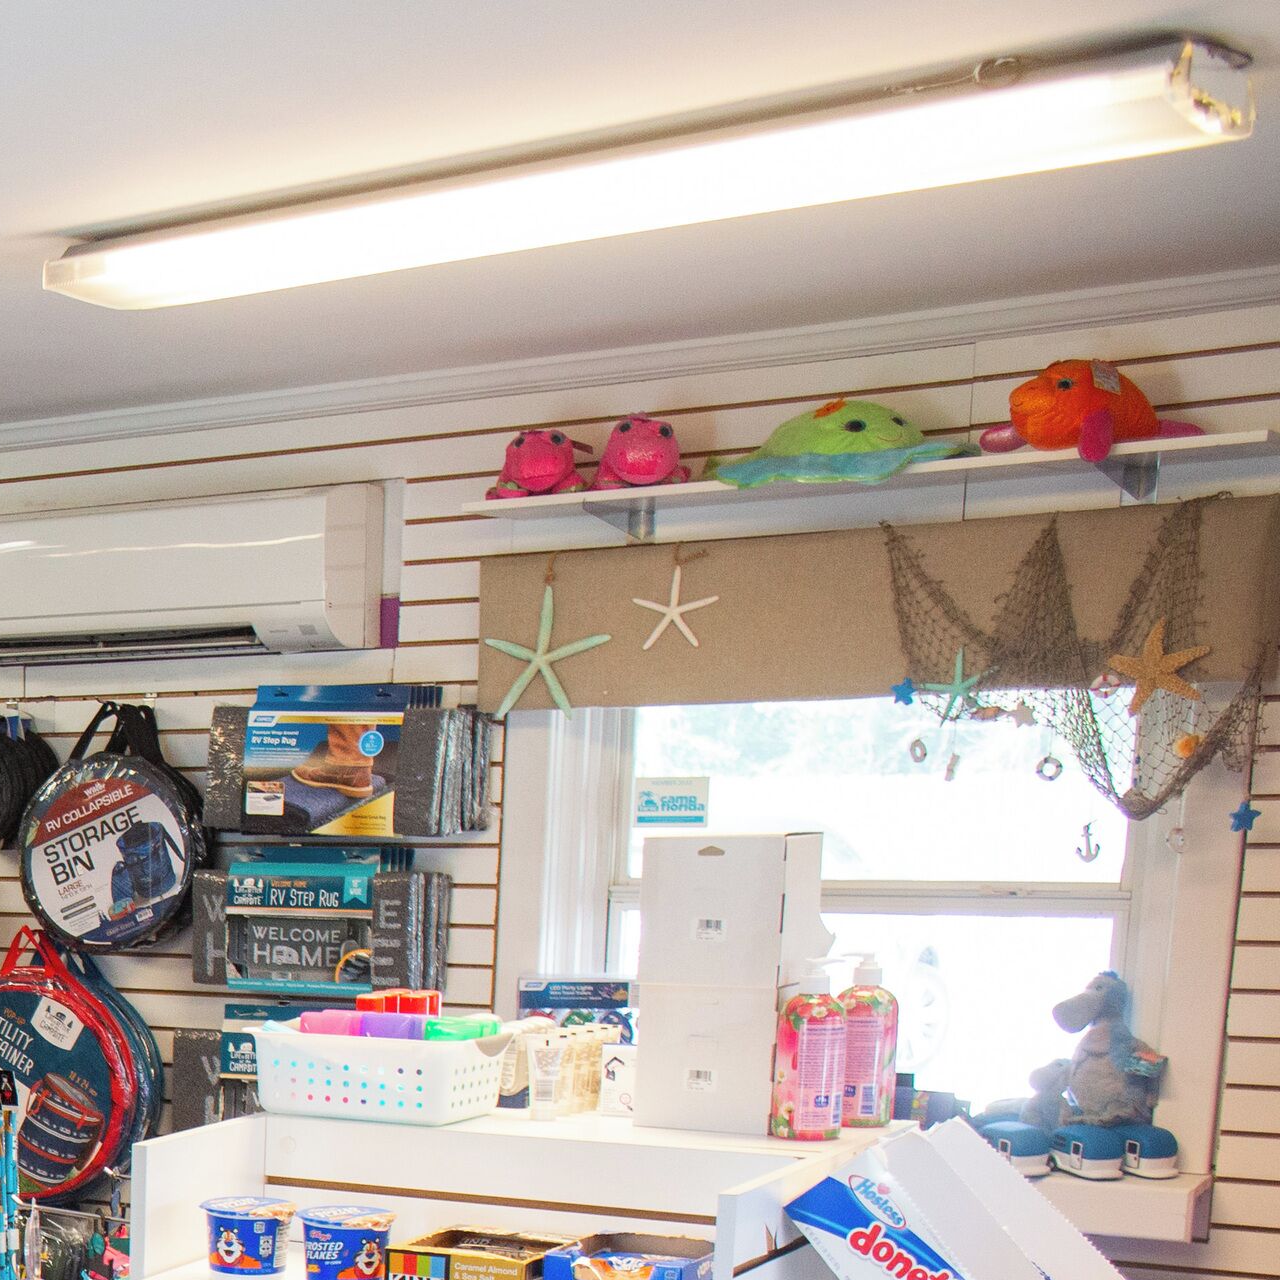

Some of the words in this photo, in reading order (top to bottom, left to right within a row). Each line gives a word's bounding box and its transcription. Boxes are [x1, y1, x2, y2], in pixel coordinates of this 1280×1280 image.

[263, 737, 280, 746] Step
[281, 737, 297, 746] Rug
[46, 818, 61, 832] RV
[63, 785, 134, 825] COLLAPSIBLE
[44, 806, 142, 864] STORAGE
[50, 851, 95, 885] BIN
[58, 879, 84, 895] LARGE
[270, 889, 286, 906] RV
[252, 926, 340, 943] WELCOME
[855, 1178, 903, 1226] Hostess
[454, 1263, 486, 1273] Caramel
[488, 1265, 517, 1276] Almond
[463, 1273, 476, 1280] Sea
